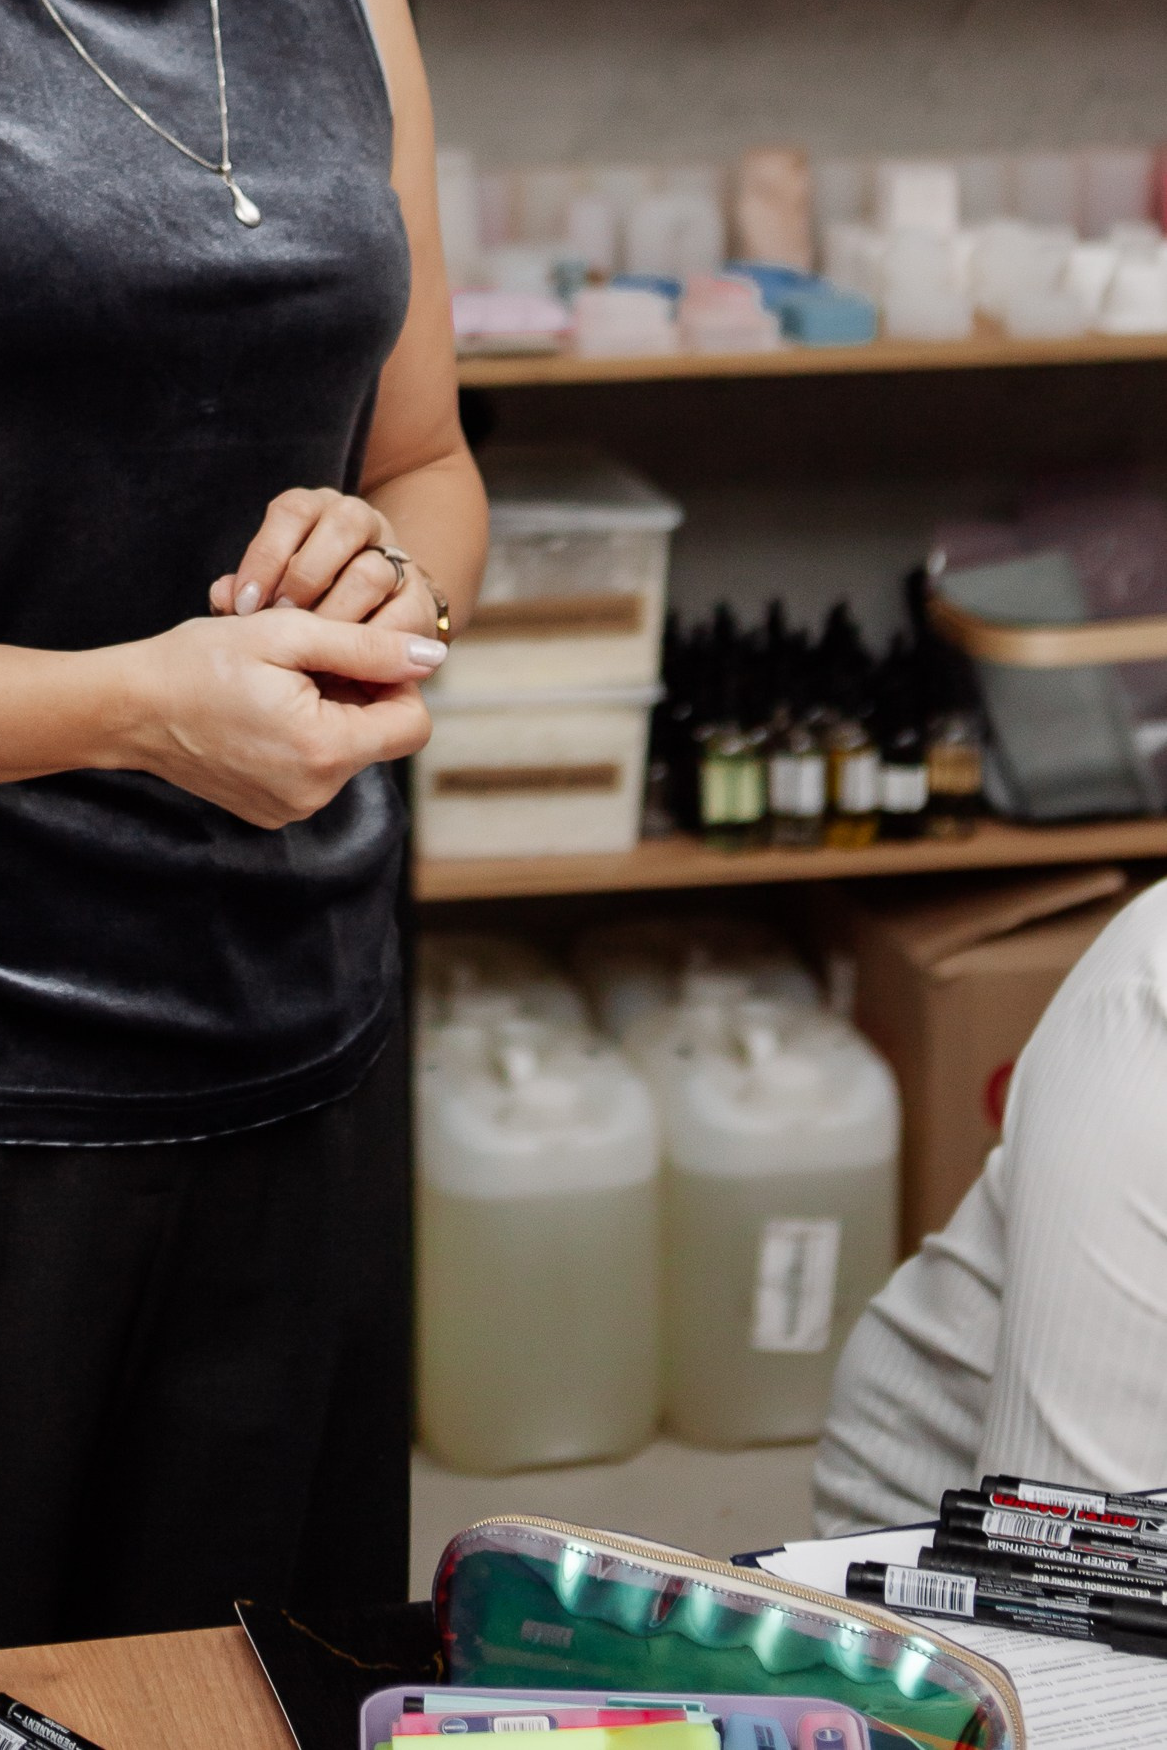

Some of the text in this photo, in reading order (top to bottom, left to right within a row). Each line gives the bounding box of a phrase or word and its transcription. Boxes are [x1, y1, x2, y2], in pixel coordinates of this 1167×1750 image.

[987, 1539, 1081, 1565] ПЕРМАНЕНТНЫЙ
[1084, 1557, 1129, 1571] МАРКЕР
[1034, 1562, 1076, 1573] МАРКЕР
[1032, 1574, 1051, 1584] ДЛЯ
[1051, 1575, 1083, 1588] ЛЮБЫХ
[1084, 1578, 1151, 1599] ПОВЕРХНОСТЕЙ
[22, 1716, 77, 1750] PERMANENT
